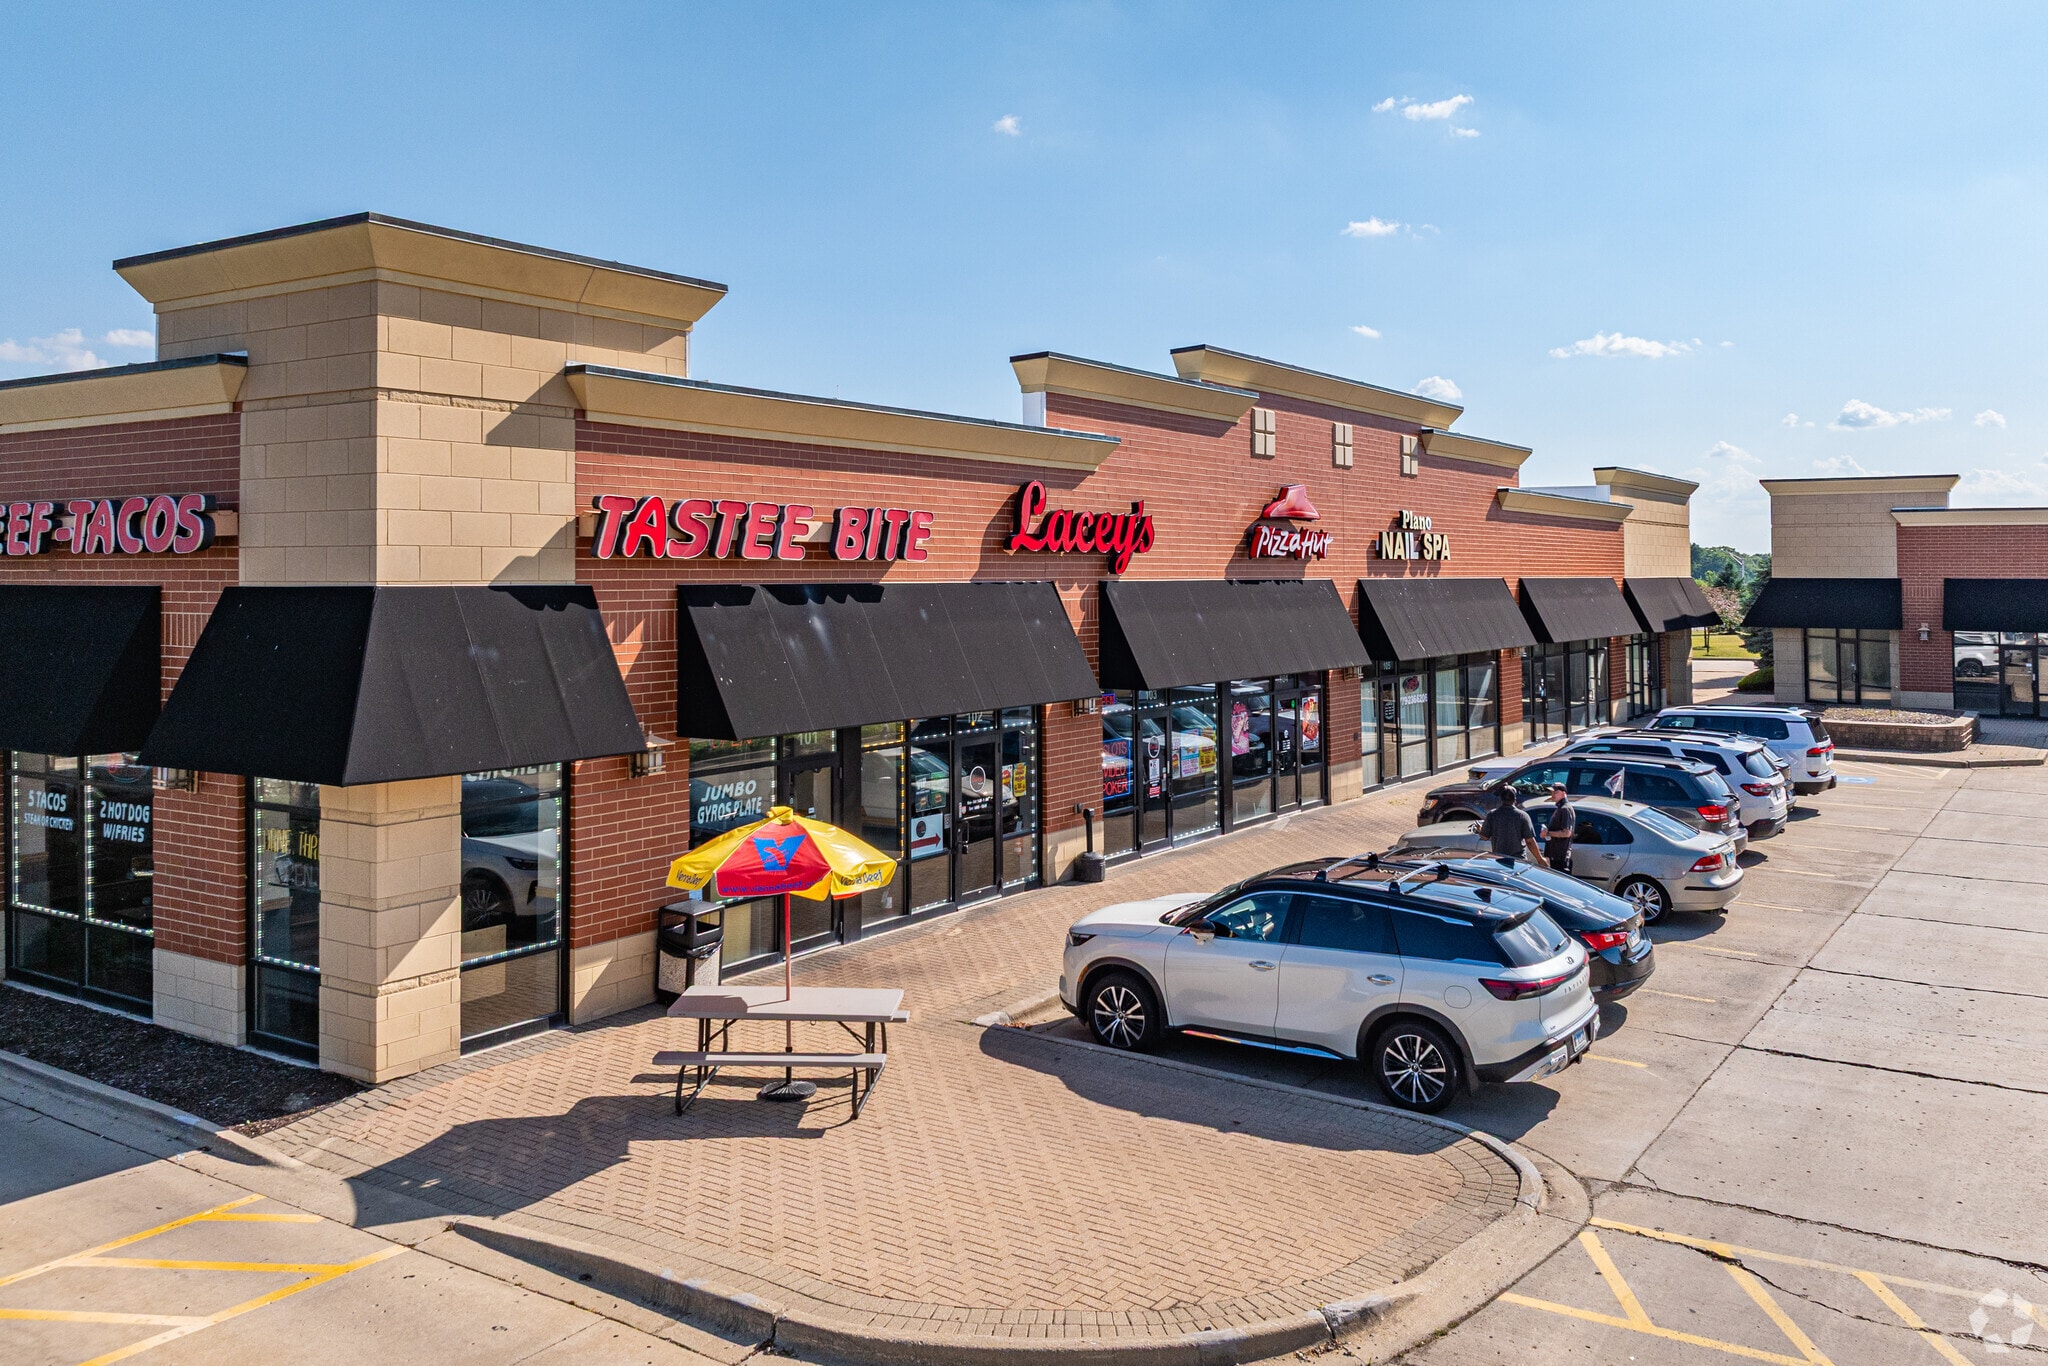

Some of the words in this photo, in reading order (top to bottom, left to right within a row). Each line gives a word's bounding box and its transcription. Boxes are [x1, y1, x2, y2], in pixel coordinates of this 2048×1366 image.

[593, 494, 814, 560] TASTEE
[831, 505, 934, 562] BITE
[1004, 479, 1155, 575] Lacey's
[1401, 509, 1432, 531] Plano
[1253, 525, 1302, 559] Pizza
[1300, 527, 1334, 559] Hut
[1380, 531, 1419, 560] NAIL
[1423, 532, 1451, 560] SPA
[28, 790, 35, 807] 5
[36, 790, 67, 812] TACOS
[700, 779, 757, 803] JUMBO
[100, 800, 108, 818] 2
[108, 801, 127, 820] HOT
[129, 805, 150, 823] DOG
[697, 802, 732, 825] GYROS
[733, 796, 762, 817] PLATE
[103, 823, 145, 843] W/FRIES
